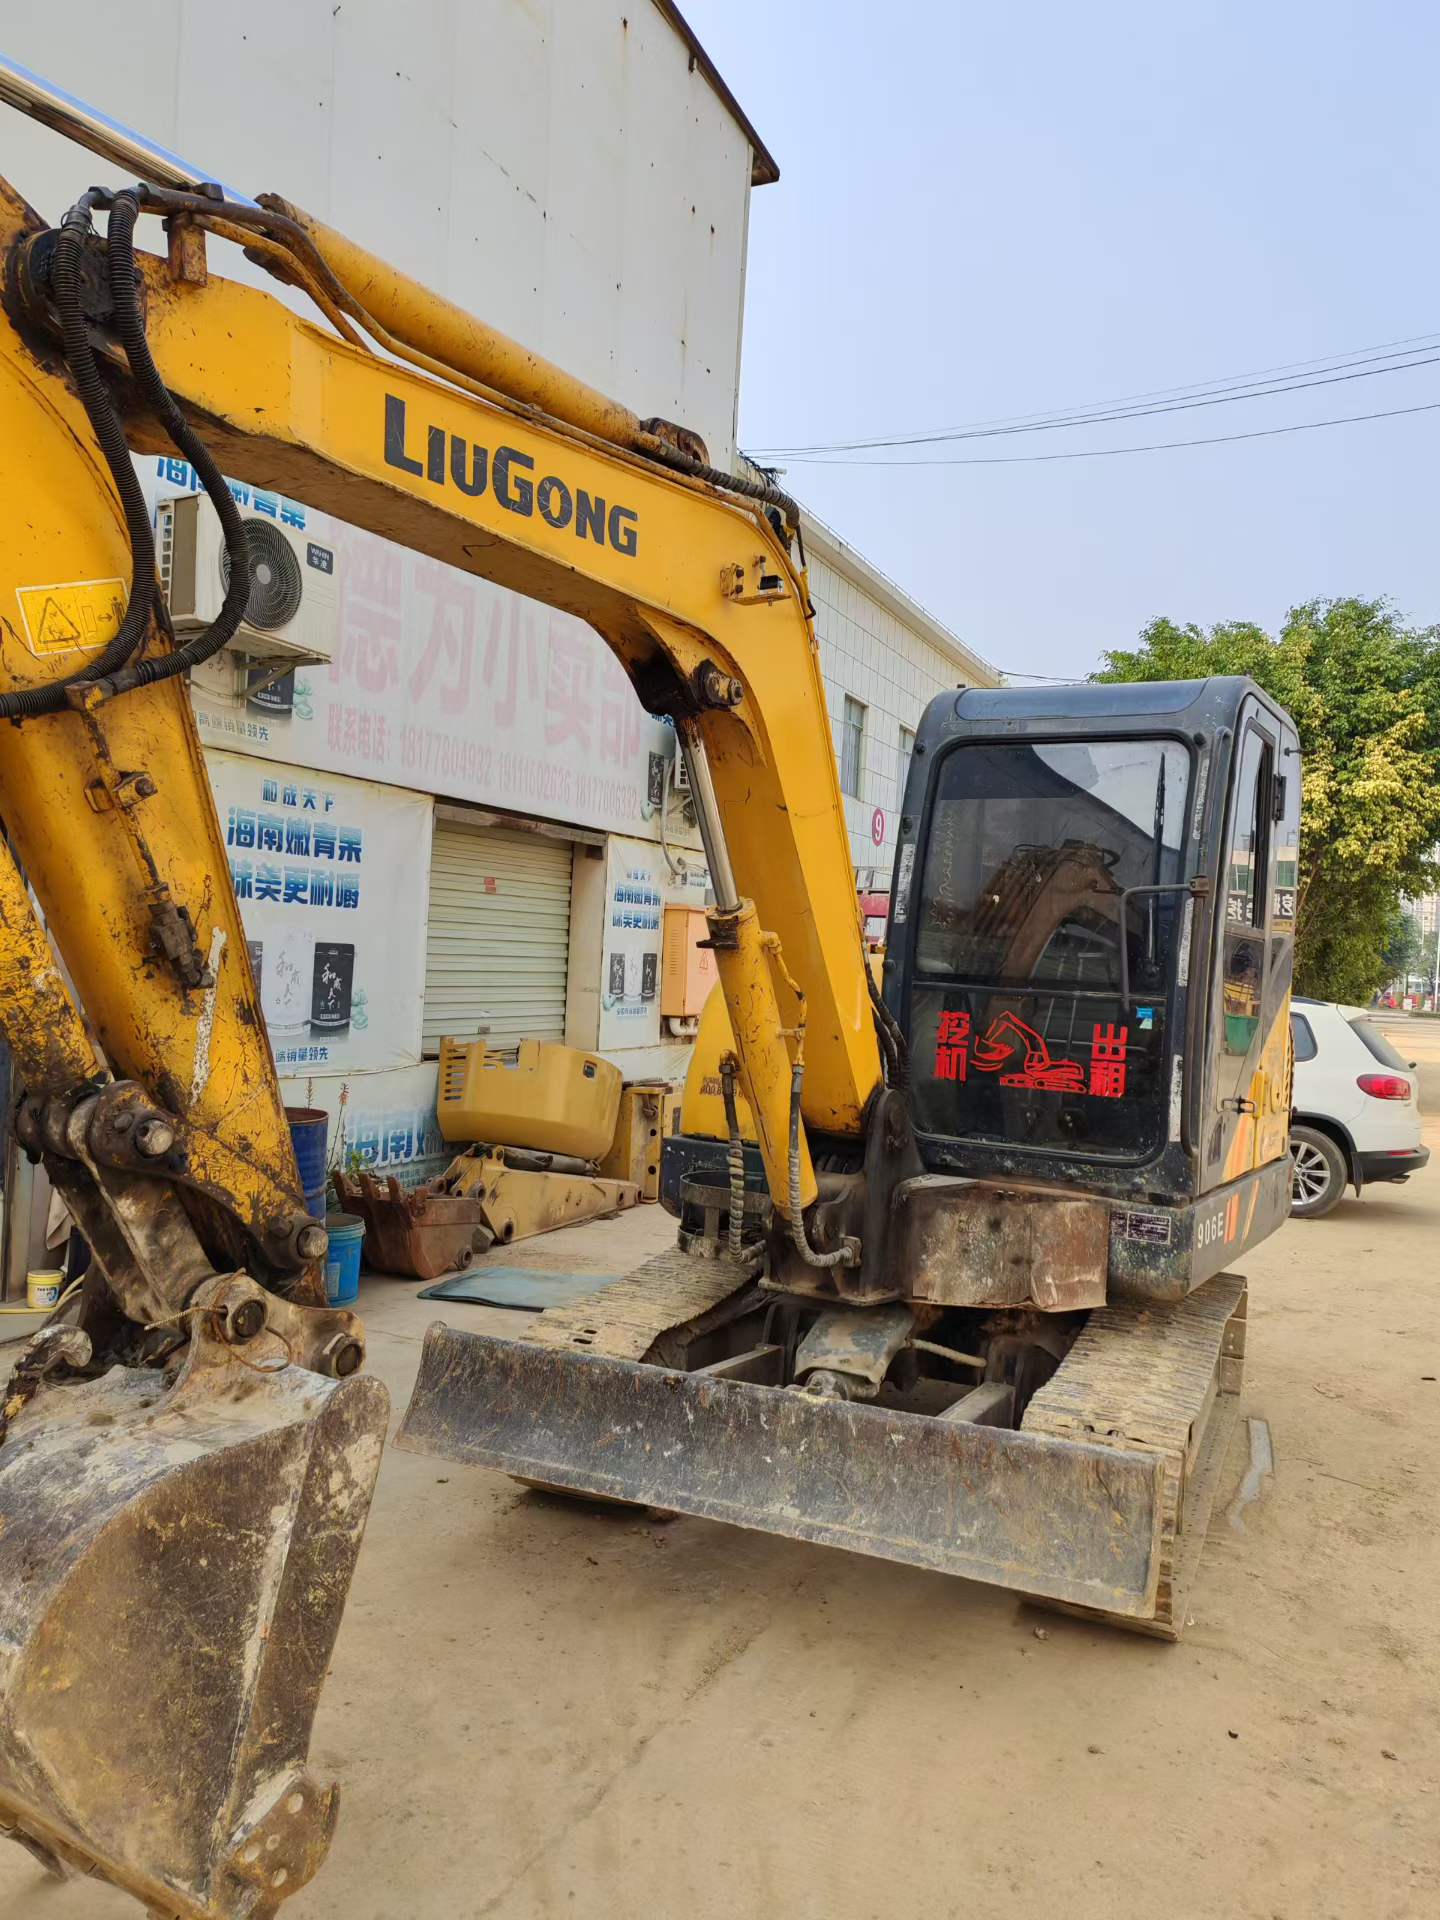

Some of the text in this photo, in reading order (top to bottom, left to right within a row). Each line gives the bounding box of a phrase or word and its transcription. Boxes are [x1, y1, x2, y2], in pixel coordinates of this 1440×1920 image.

[226, 806, 363, 864] 海南嫩青果
[873, 812, 883, 842] 9
[932, 1010, 971, 1086] 挖机
[1088, 1023, 1129, 1099] 出租
[1197, 1211, 1225, 1249] 906E
